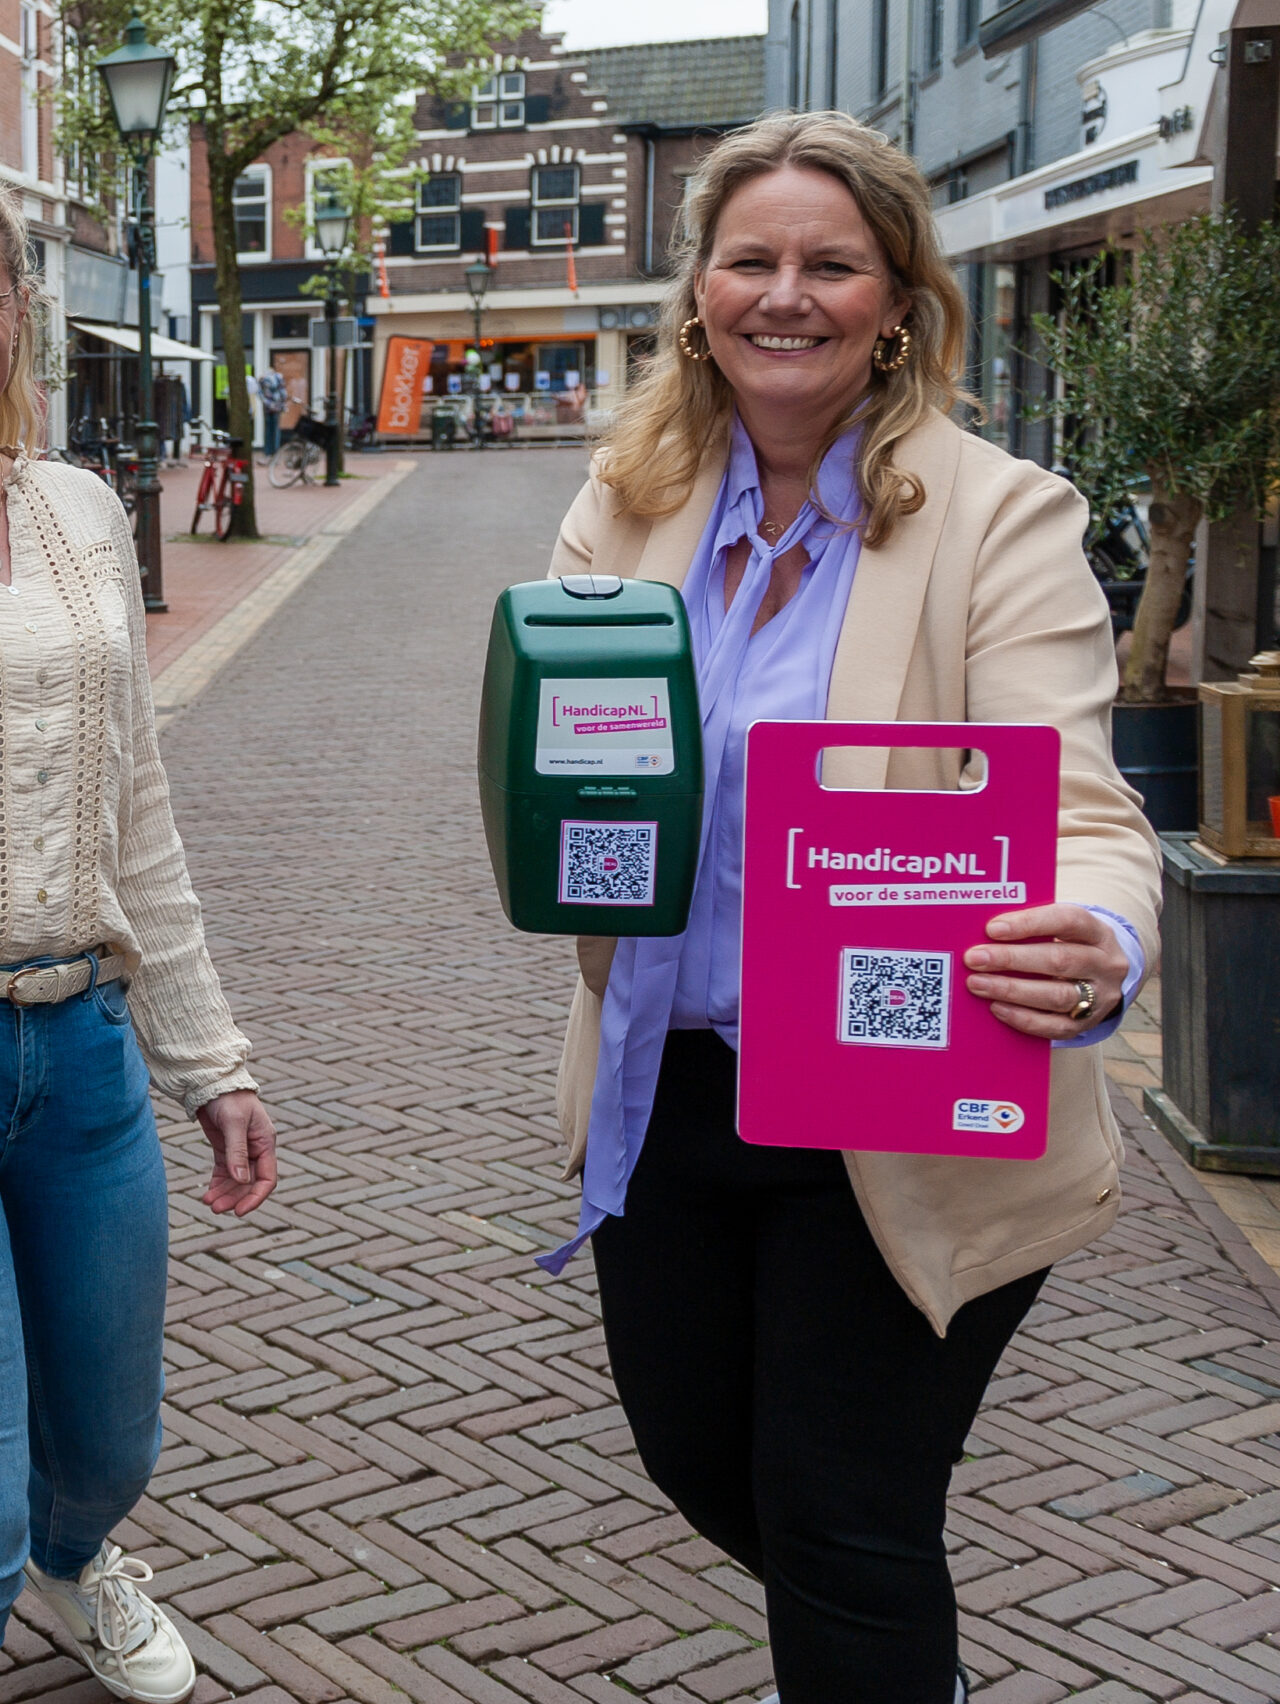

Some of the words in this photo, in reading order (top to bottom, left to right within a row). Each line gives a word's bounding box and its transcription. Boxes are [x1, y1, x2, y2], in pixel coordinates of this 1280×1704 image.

[388, 346, 419, 427] blokker
[562, 704, 648, 718] HandicapNL
[598, 723, 608, 731] de
[610, 720, 664, 730] samenwereld
[549, 758, 603, 766] www.handicap.nl
[808, 847, 986, 878] HandicapNL
[834, 890, 873, 901] voor
[878, 888, 898, 900] de
[904, 886, 1018, 900] samenwereld
[958, 1102, 990, 1113] CBF
